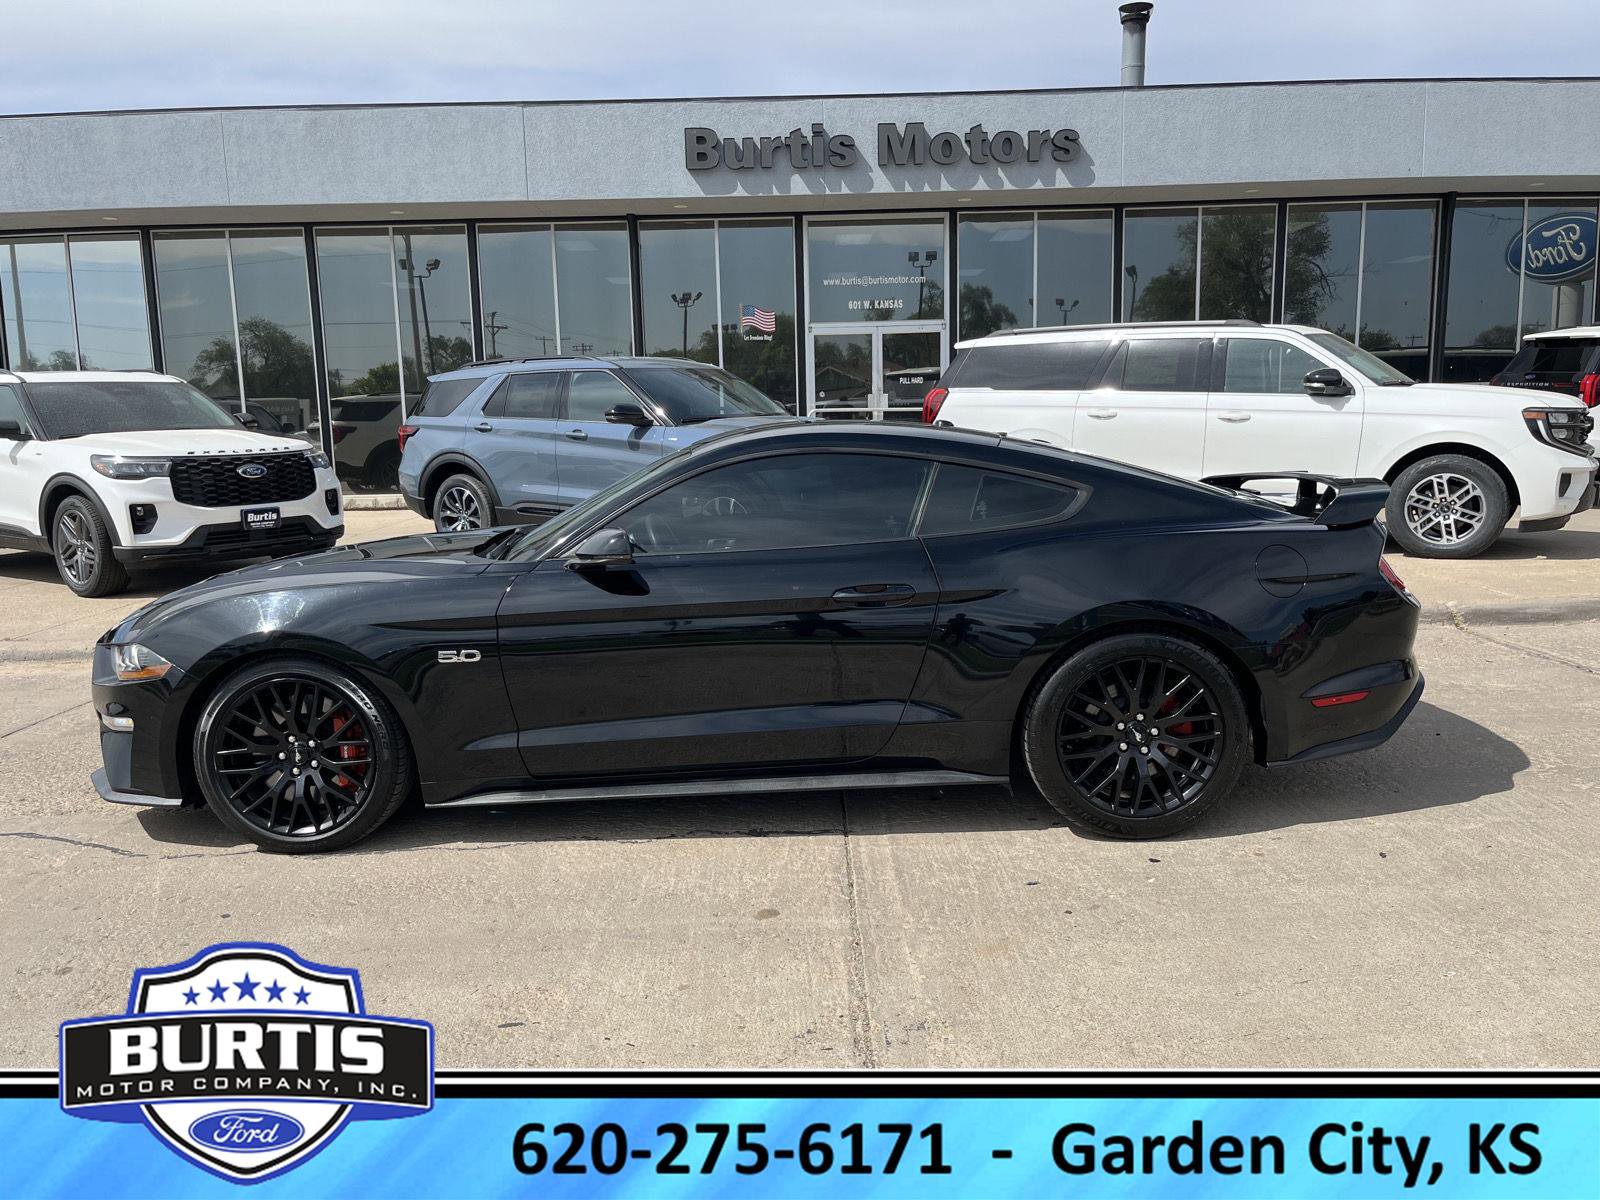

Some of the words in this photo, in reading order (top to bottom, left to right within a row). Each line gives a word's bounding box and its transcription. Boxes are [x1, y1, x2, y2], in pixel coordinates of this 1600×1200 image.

[684, 123, 856, 171] Burtis
[877, 122, 1081, 167] Motors
[823, 276, 926, 286] www.burtis@burtismotor.com
[848, 300, 862, 310] 601
[863, 300, 873, 310] W.
[874, 299, 904, 309] KANSAS
[899, 376, 911, 385] PULL
[911, 376, 924, 384] HARD
[187, 446, 290, 454] EXPLORER
[247, 512, 277, 522] Burtis
[437, 649, 482, 663] 5.0
